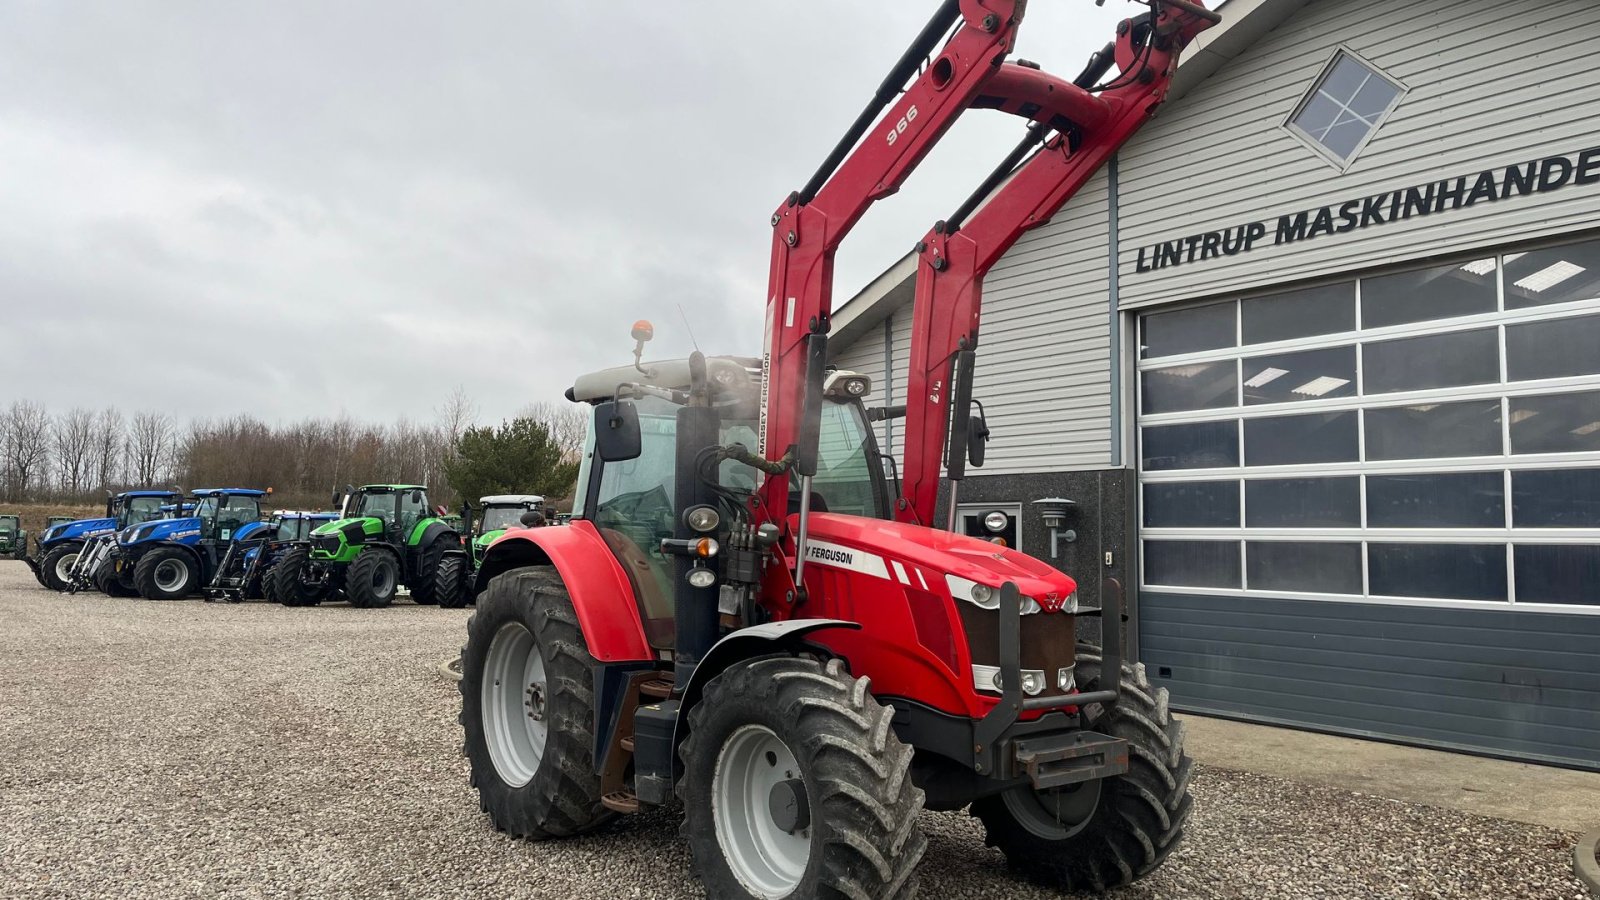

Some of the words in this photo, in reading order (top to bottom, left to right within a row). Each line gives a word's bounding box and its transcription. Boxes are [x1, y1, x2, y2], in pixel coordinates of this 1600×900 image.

[887, 104, 918, 146] 966
[1136, 222, 1265, 273] LINTRUP
[1275, 148, 1600, 246] MASKINHANDE
[761, 353, 770, 409] FERGUSON
[759, 412, 767, 455] MASSEY
[811, 546, 853, 565] FERGUSON
